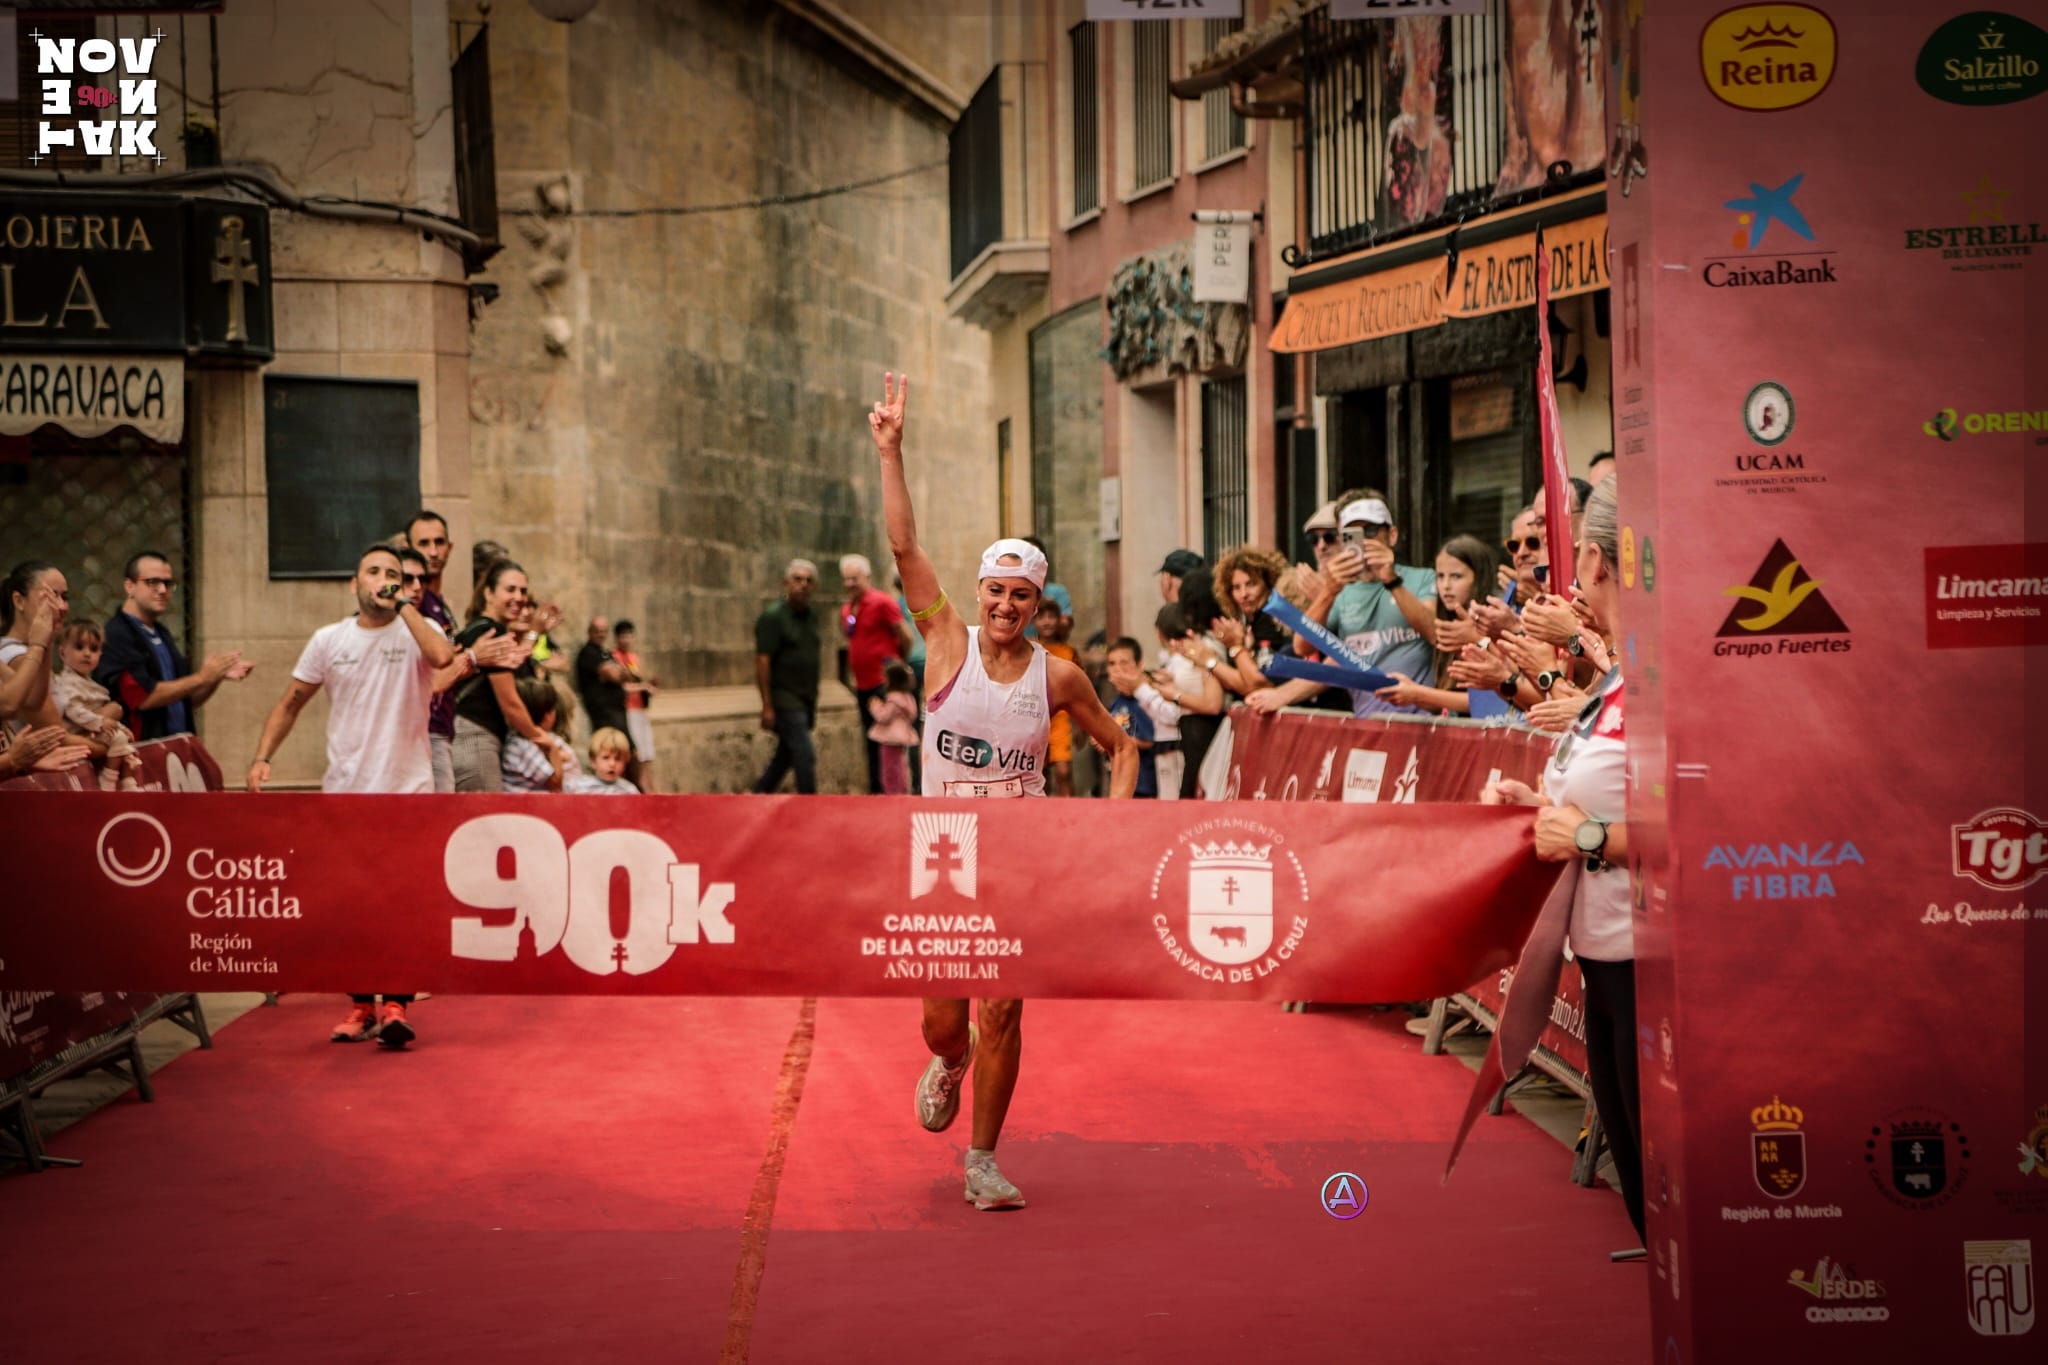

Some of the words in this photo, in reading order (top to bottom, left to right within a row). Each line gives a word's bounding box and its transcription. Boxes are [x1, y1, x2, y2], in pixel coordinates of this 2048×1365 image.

[1720, 57, 1818, 87] Reina
[1943, 54, 2040, 80] Salzillo
[0, 214, 154, 251] OJERIA
[1943, 249, 1962, 259] DE
[1965, 246, 2032, 258] LEVANTE
[1461, 262, 1480, 311] EL
[1486, 254, 1537, 308] RASTR
[1551, 243, 1573, 293] DE
[1579, 238, 1598, 285] LA
[1703, 260, 1837, 289] CaixaBank
[0, 363, 163, 419] ARAVACA
[1736, 454, 1804, 471] UCAM
[1936, 608, 1985, 622] Limpieza
[1985, 610, 1993, 622] y
[1993, 606, 2041, 618] Servicios
[1713, 638, 1773, 659] Grupo
[1777, 638, 1852, 656] Fuertes
[1178, 818, 1284, 845] AYUNTAMIENTO
[186, 848, 287, 881] Costa
[1703, 841, 1865, 870] AVANZA
[444, 812, 735, 976] 90k
[1733, 874, 1837, 899] FIBRA
[186, 886, 303, 920] Cálida
[2010, 902, 2031, 920] de
[883, 914, 997, 933] CARAVACA
[190, 932, 252, 955] Región
[861, 937, 887, 956] DE
[890, 938, 914, 956] LA
[917, 938, 971, 956] CRUZ
[974, 938, 1023, 956] 2024
[1153, 913, 1225, 983] CARAVACA
[1229, 969, 1254, 984] DE
[1257, 957, 1280, 977] LA
[1277, 915, 1309, 960] CRUZ
[190, 956, 212, 974] de
[216, 957, 279, 974] Murcia
[884, 958, 924, 979] AÑO
[928, 961, 1000, 982] JUBILAR
[1721, 1204, 1770, 1222] Región
[1774, 1206, 1792, 1219] de
[1795, 1204, 1842, 1219] Murcia
